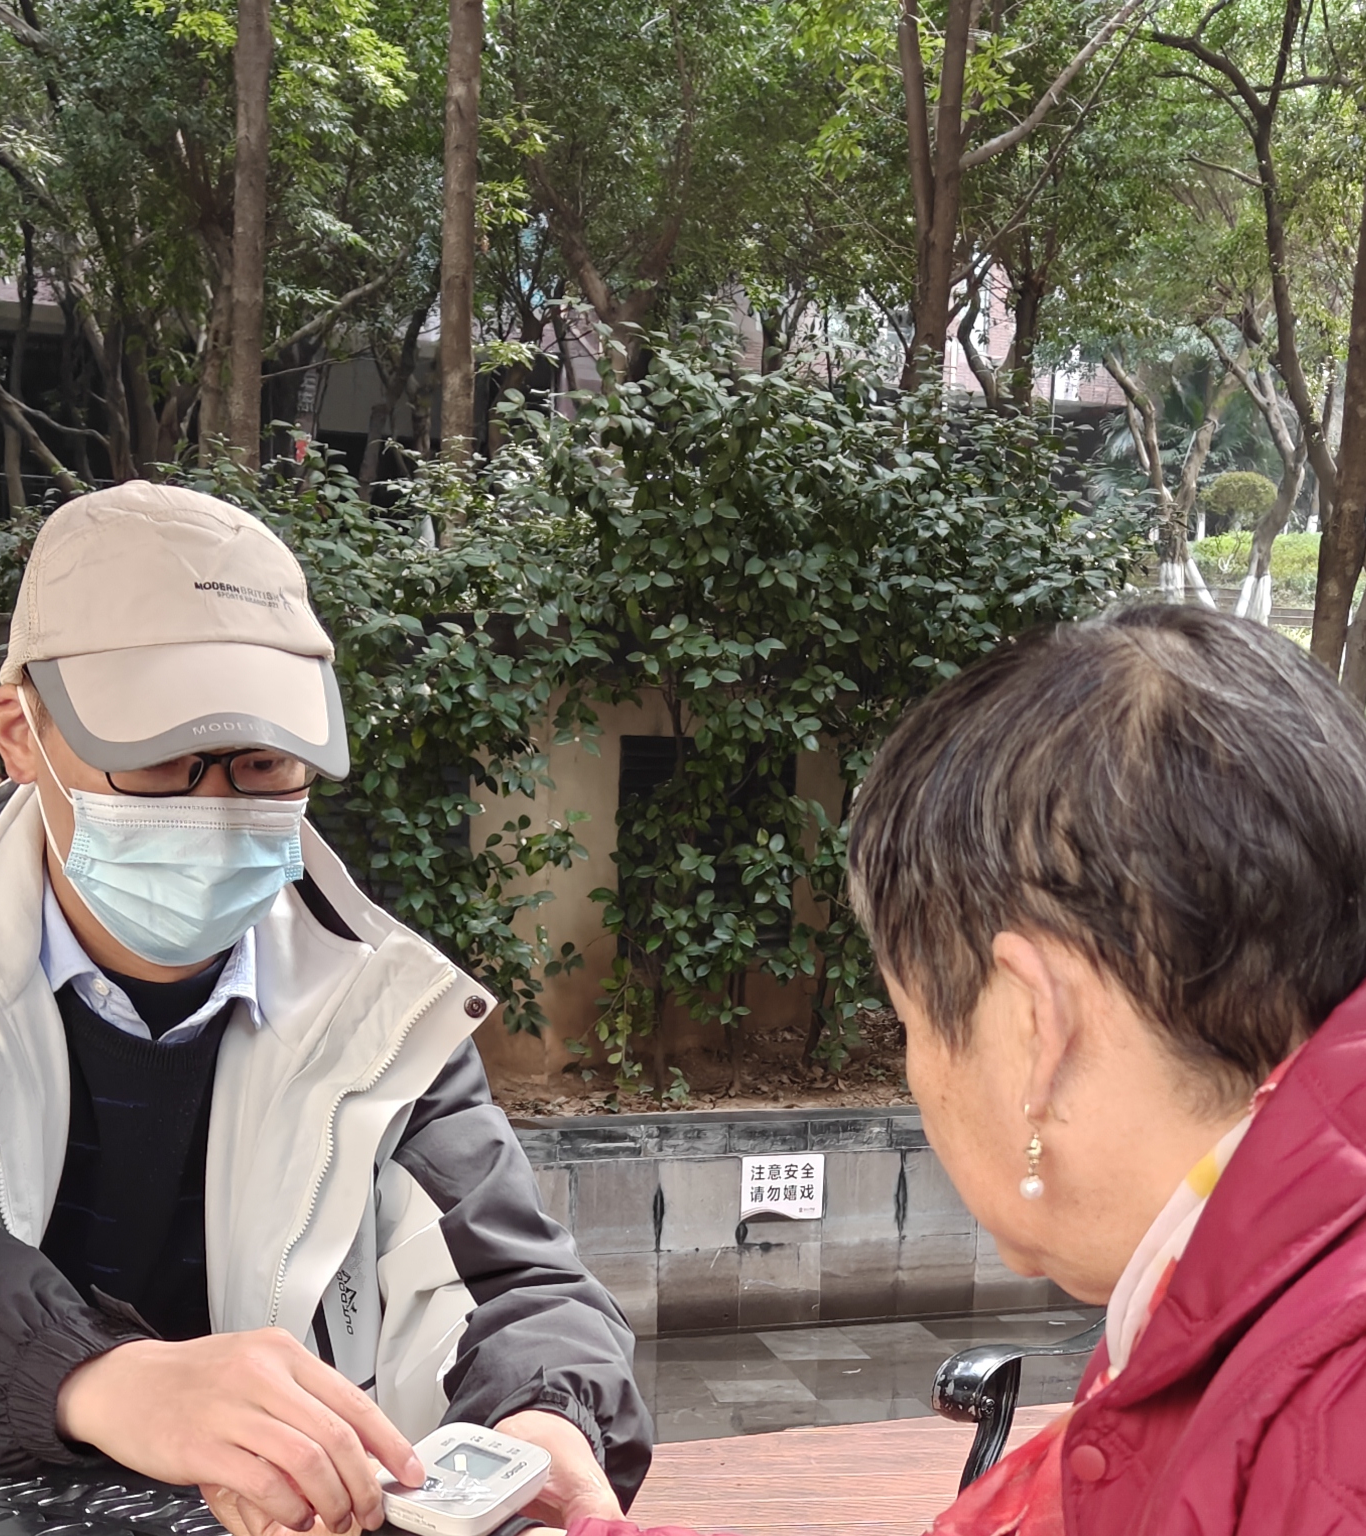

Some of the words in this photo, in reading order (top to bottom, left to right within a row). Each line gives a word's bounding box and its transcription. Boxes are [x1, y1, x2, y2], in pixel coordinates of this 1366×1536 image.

[750, 1162, 815, 1182] 注意安全
[750, 1184, 815, 1203] 请勿嬉戏
